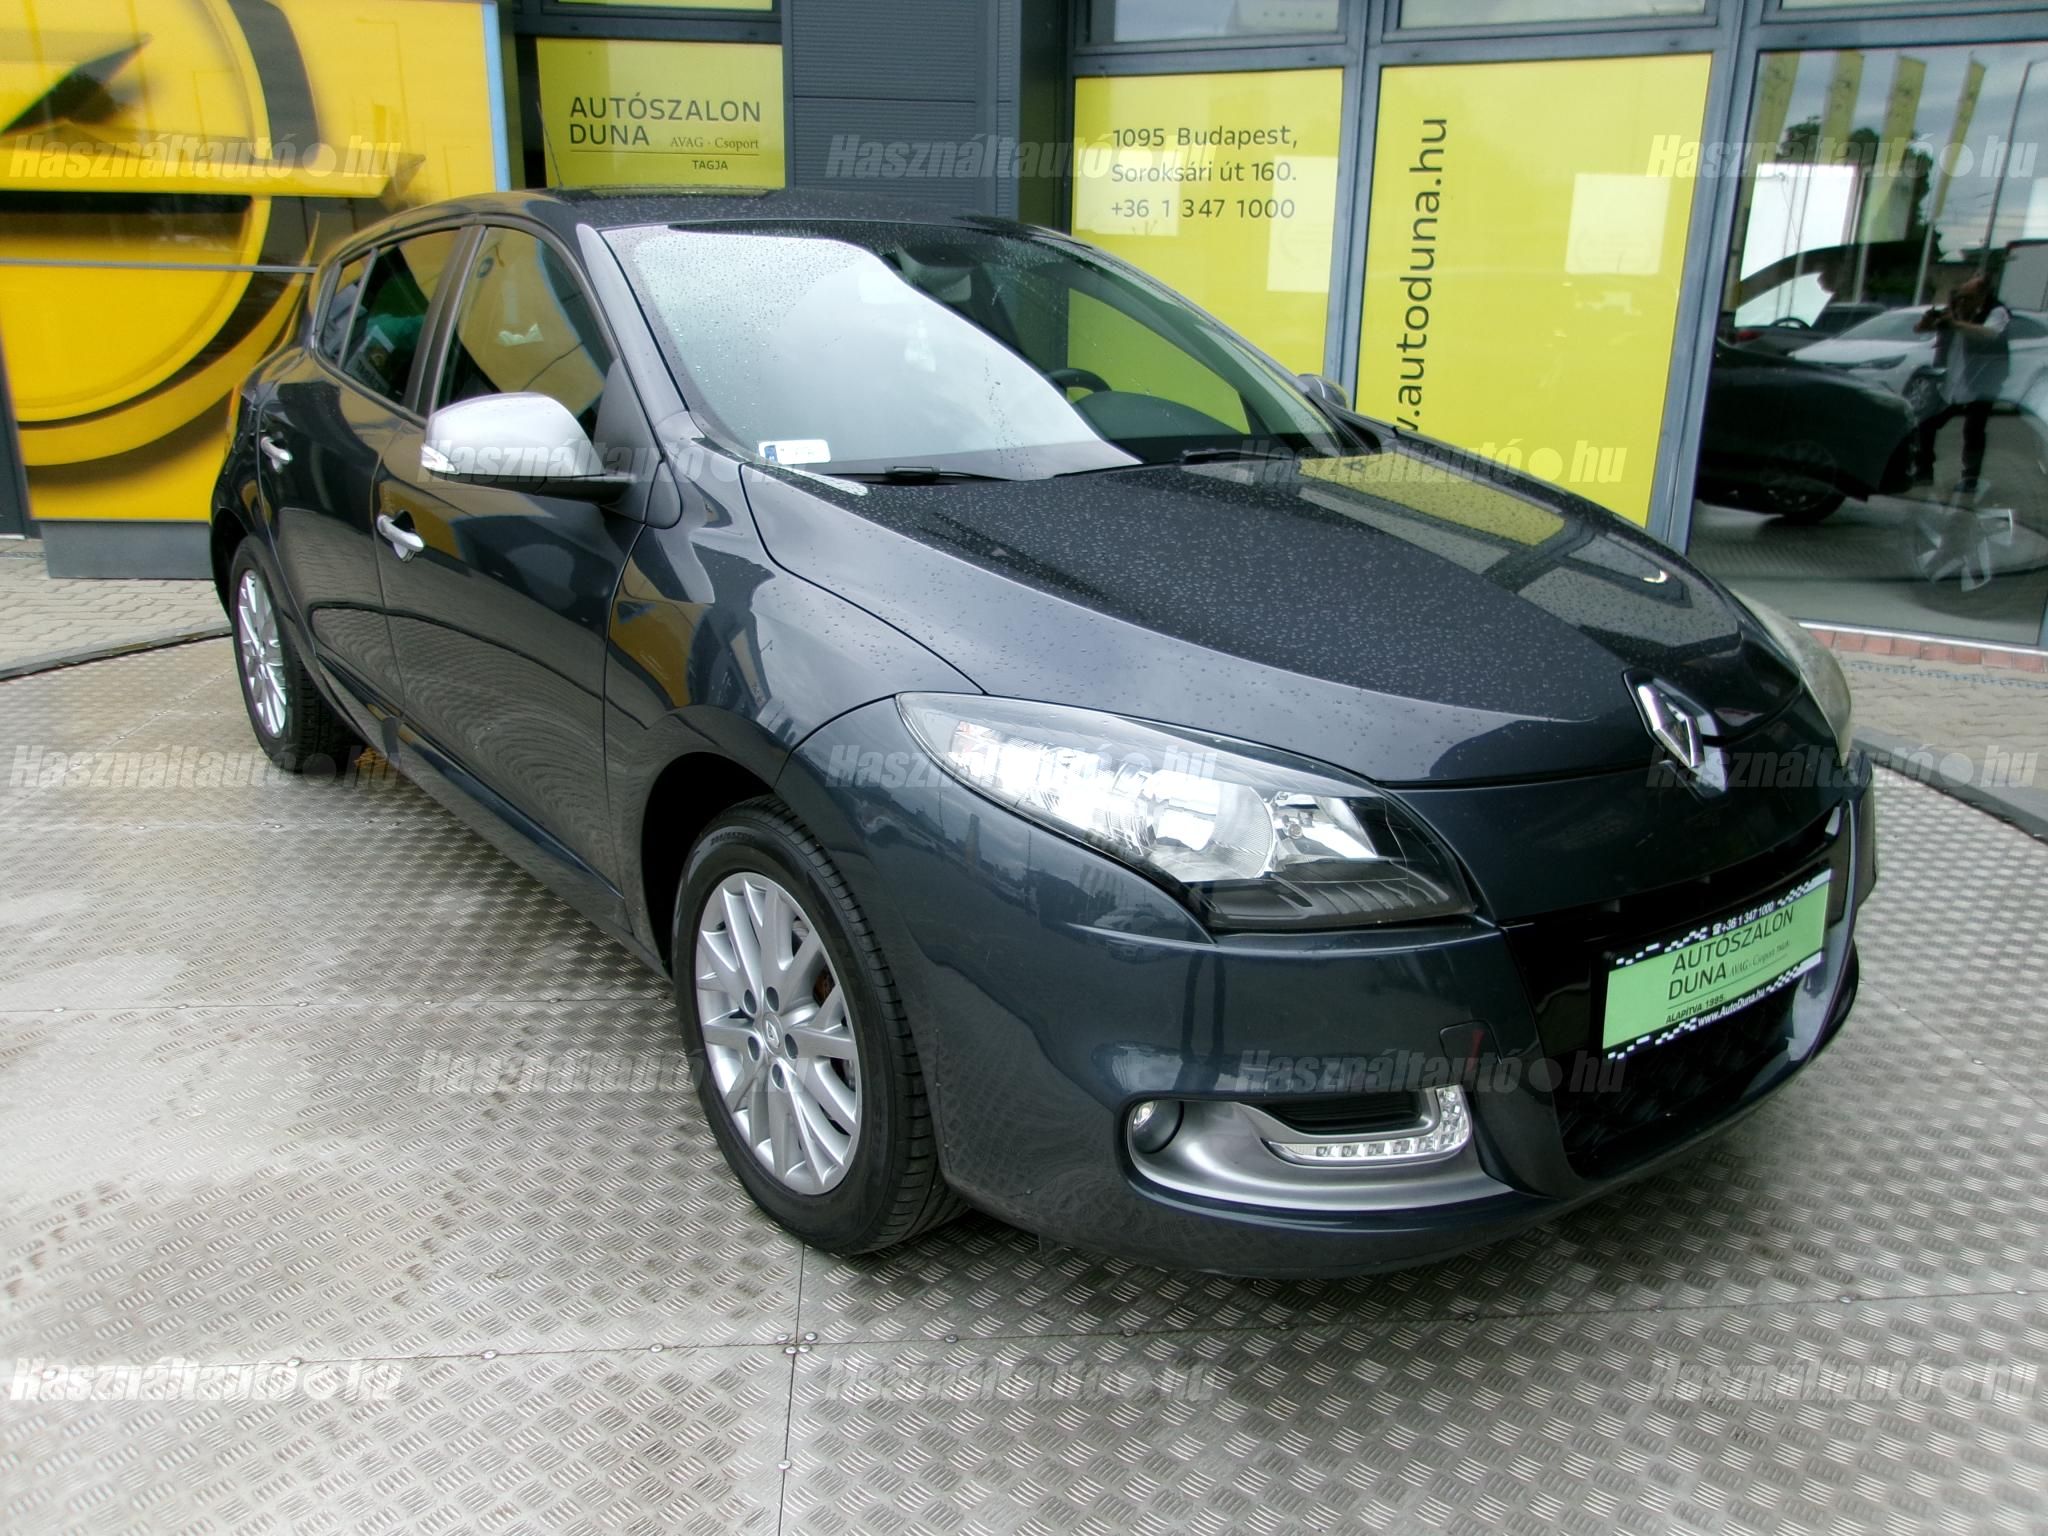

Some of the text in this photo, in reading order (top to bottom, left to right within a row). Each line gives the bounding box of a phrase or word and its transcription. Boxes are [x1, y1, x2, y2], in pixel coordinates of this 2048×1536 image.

[570, 92, 761, 122] AUTÓSZALON
[570, 124, 650, 145] DUNA
[669, 137, 704, 149] AVAG
[714, 137, 759, 152] Csoport
[1112, 125, 1298, 149] 1095 Budapest,
[692, 160, 729, 170] TAGJA
[1111, 161, 1297, 182] Soroksári út 160.
[1111, 199, 1296, 219] +36 1 347 1000
[1671, 905, 1794, 975] AUTÓSZALON
[1668, 962, 1727, 1001] DUNA
